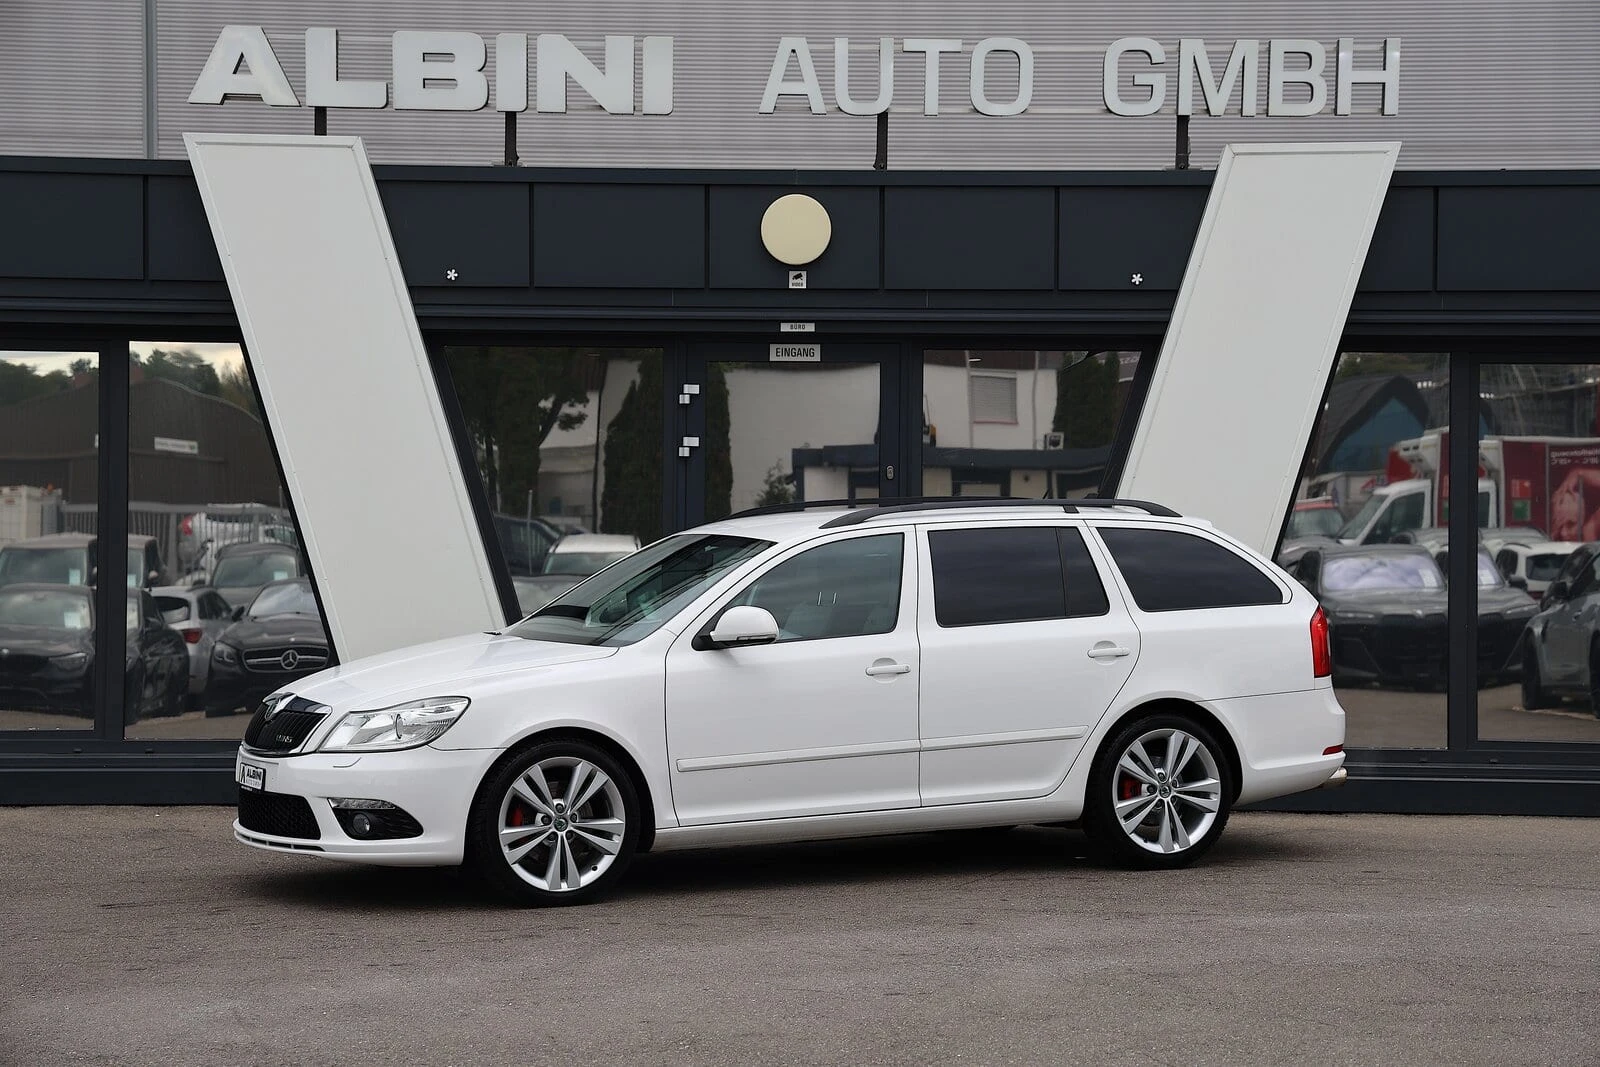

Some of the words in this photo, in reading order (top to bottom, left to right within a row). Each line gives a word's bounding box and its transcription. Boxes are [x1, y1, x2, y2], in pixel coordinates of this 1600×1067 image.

[188, 25, 674, 115] ALBINI
[758, 36, 1035, 117] AUTO
[1102, 36, 1402, 118] GMBH
[775, 347, 815, 358] EINGANG
[246, 768, 262, 781] ALBINI
